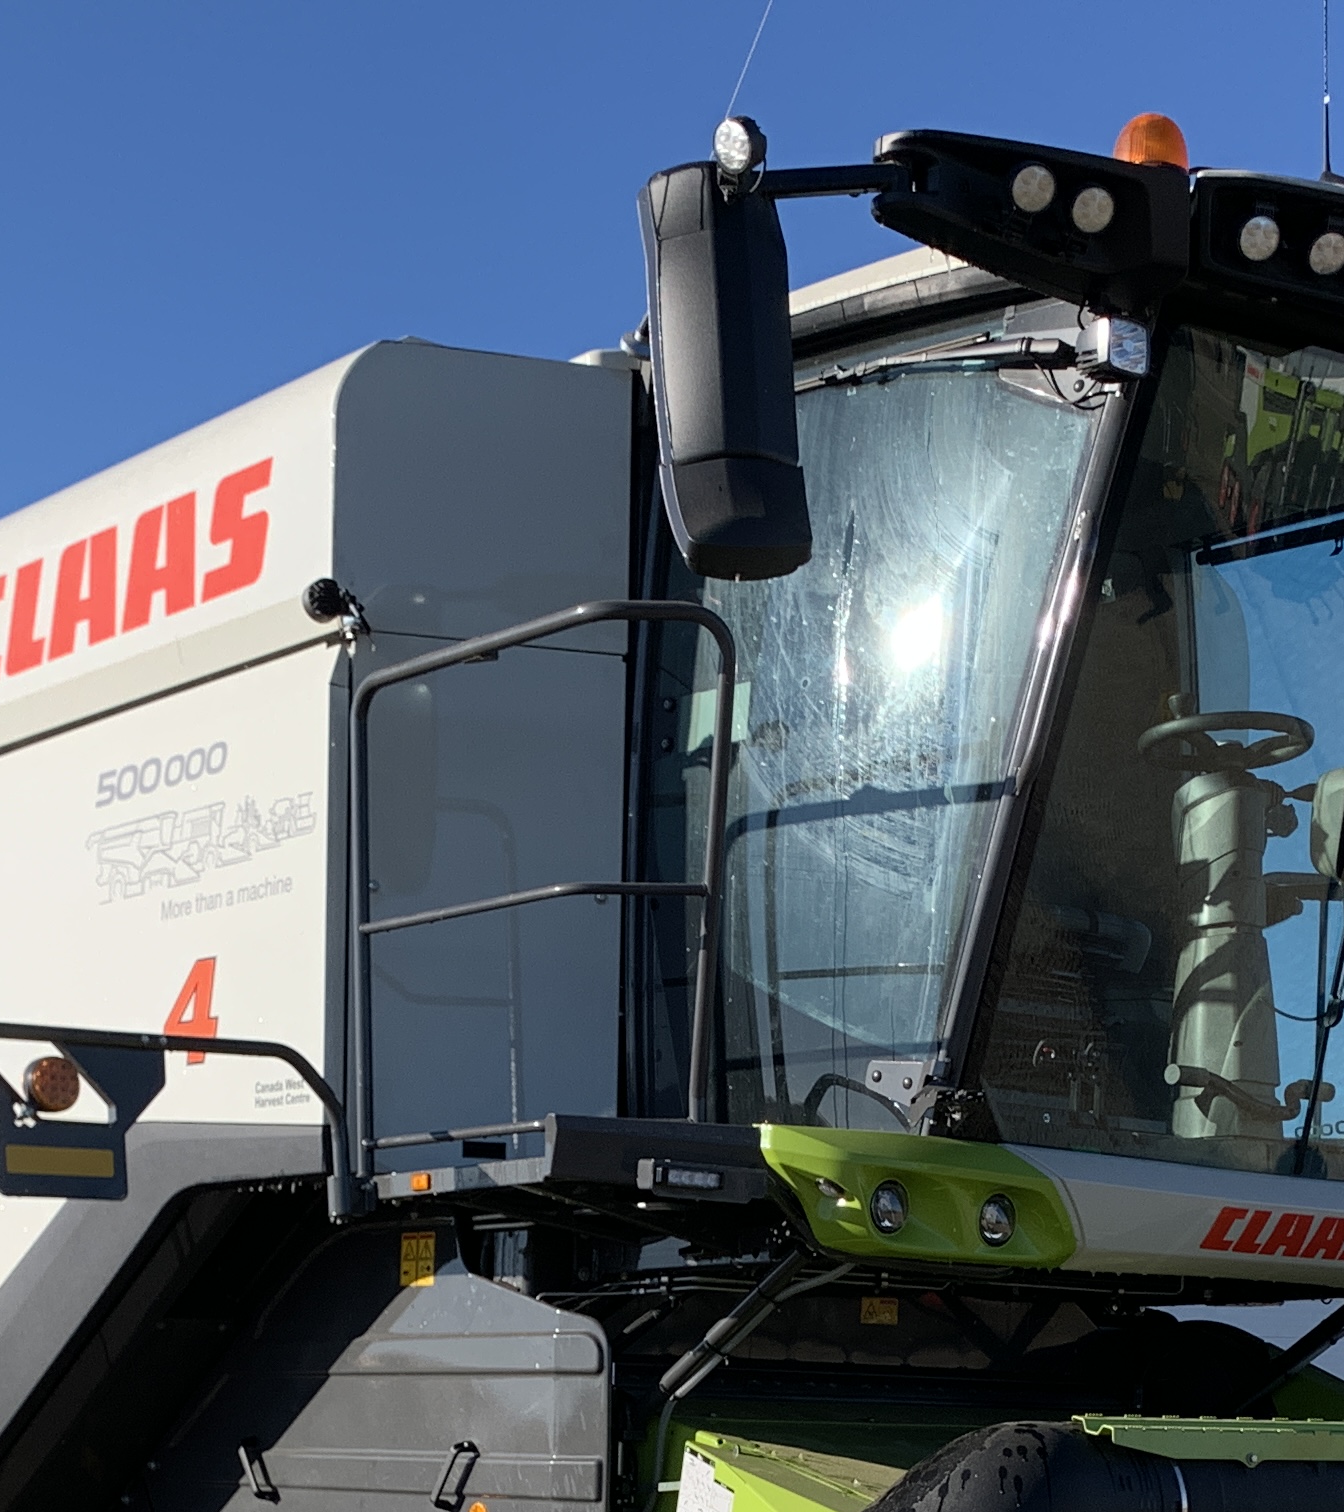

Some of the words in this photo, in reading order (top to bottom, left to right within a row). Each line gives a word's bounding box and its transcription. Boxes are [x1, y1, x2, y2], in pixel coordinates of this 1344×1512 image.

[160, 899, 192, 921] More
[195, 893, 223, 914] than
[226, 890, 234, 907] a
[237, 875, 293, 903] machine
[164, 956, 218, 1066] 4
